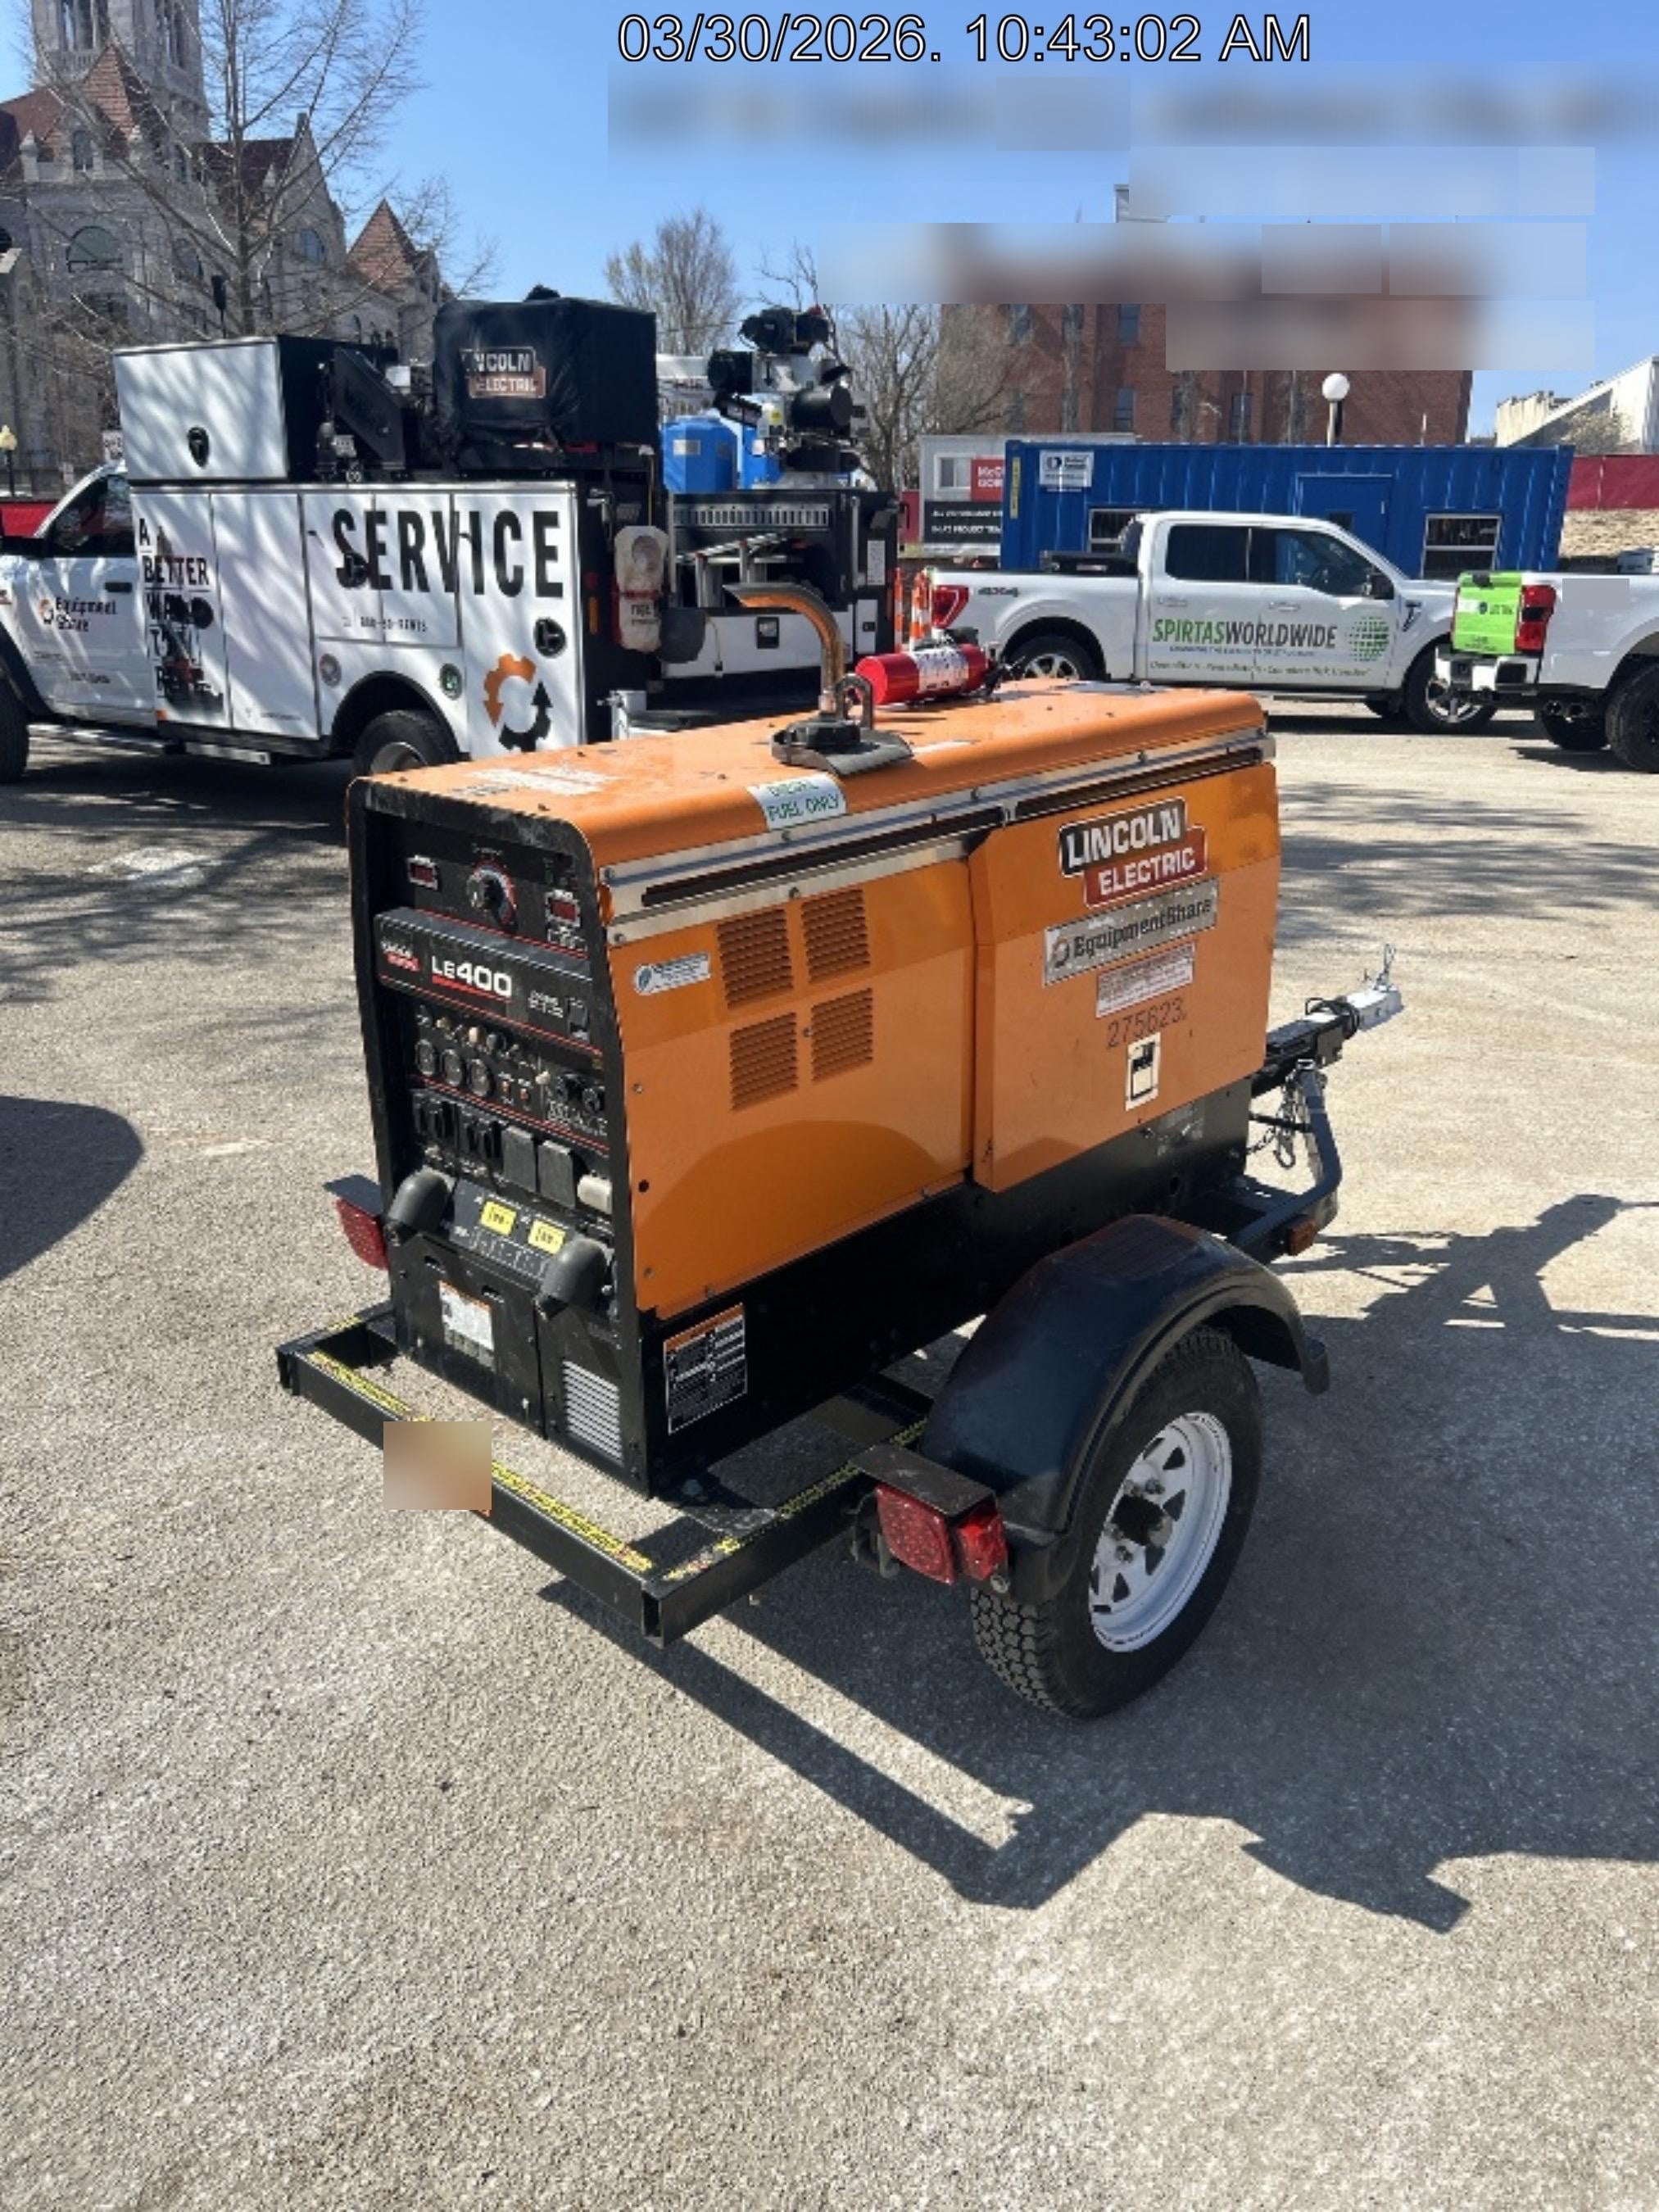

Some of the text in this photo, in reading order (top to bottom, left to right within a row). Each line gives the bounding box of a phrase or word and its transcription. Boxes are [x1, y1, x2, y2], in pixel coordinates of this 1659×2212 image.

[138, 519, 151, 546] A
[333, 509, 564, 598] SERVICE
[143, 555, 210, 586] BETTER
[766, 793, 840, 821] FUEL ONLY
[1066, 808, 1181, 868] LINCOLN
[1098, 846, 1196, 895] ELECTRIC
[1073, 899, 1212, 958] EquipmentShare
[431, 954, 513, 997] LE400
